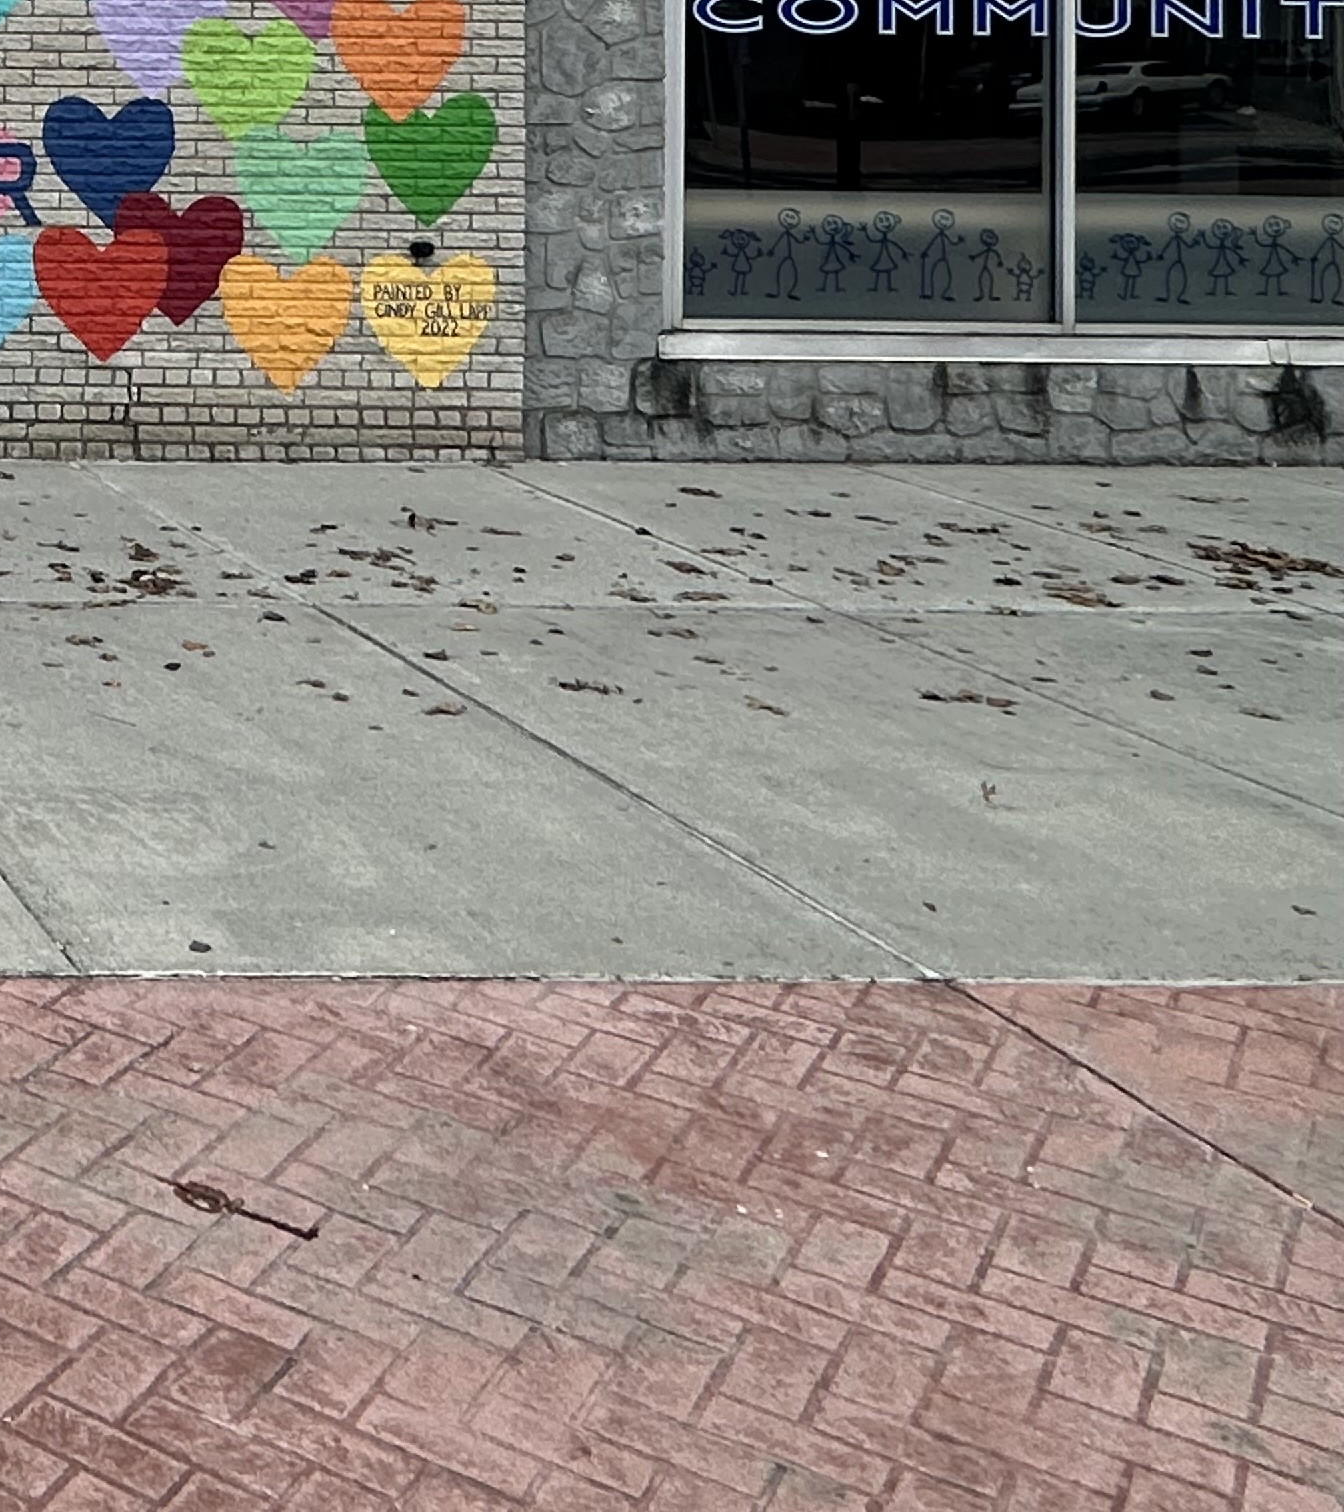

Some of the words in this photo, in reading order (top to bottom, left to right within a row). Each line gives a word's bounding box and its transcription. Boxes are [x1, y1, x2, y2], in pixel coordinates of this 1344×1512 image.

[373, 284, 433, 301] PAINTED
[443, 284, 462, 302] BY
[375, 302, 416, 318] CINDY
[421, 318, 460, 336] 2022
